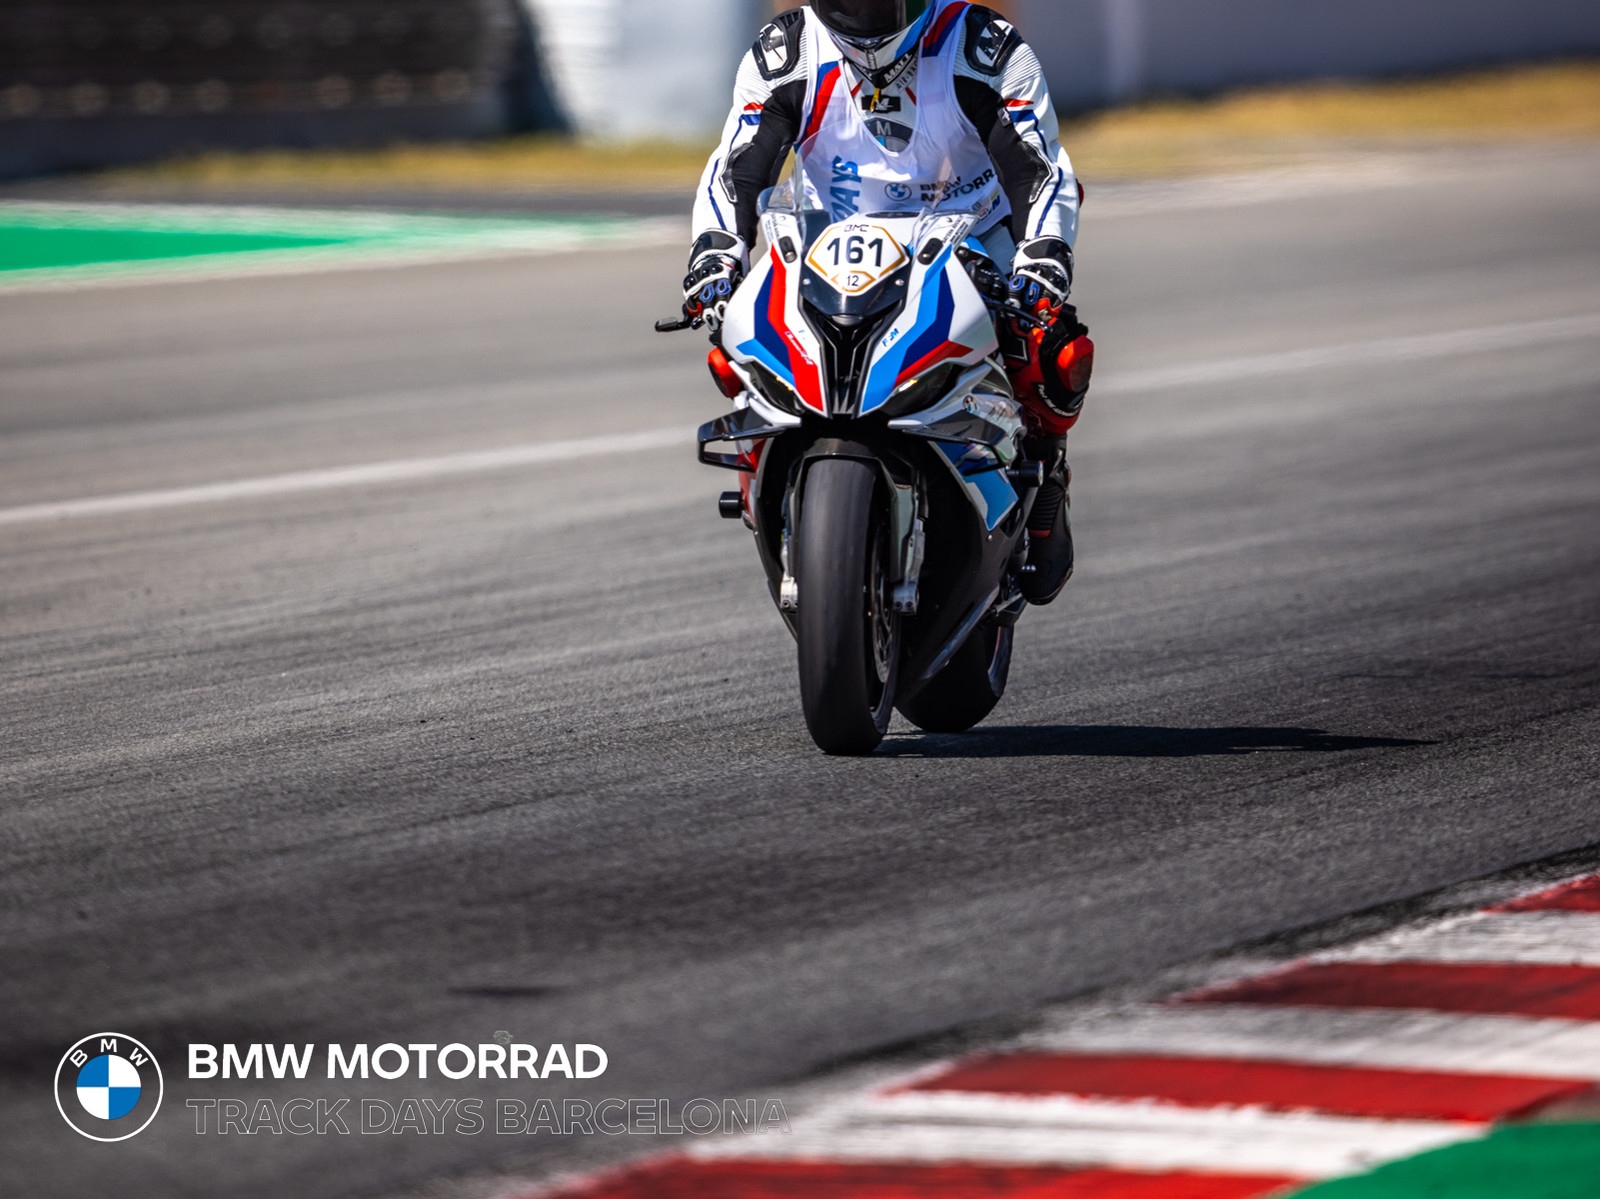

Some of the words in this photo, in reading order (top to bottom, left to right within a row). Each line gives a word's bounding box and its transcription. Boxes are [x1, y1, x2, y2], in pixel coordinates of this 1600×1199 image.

[920, 168, 995, 202] MOTORR
[827, 235, 883, 267] 161
[846, 275, 859, 287] 12
